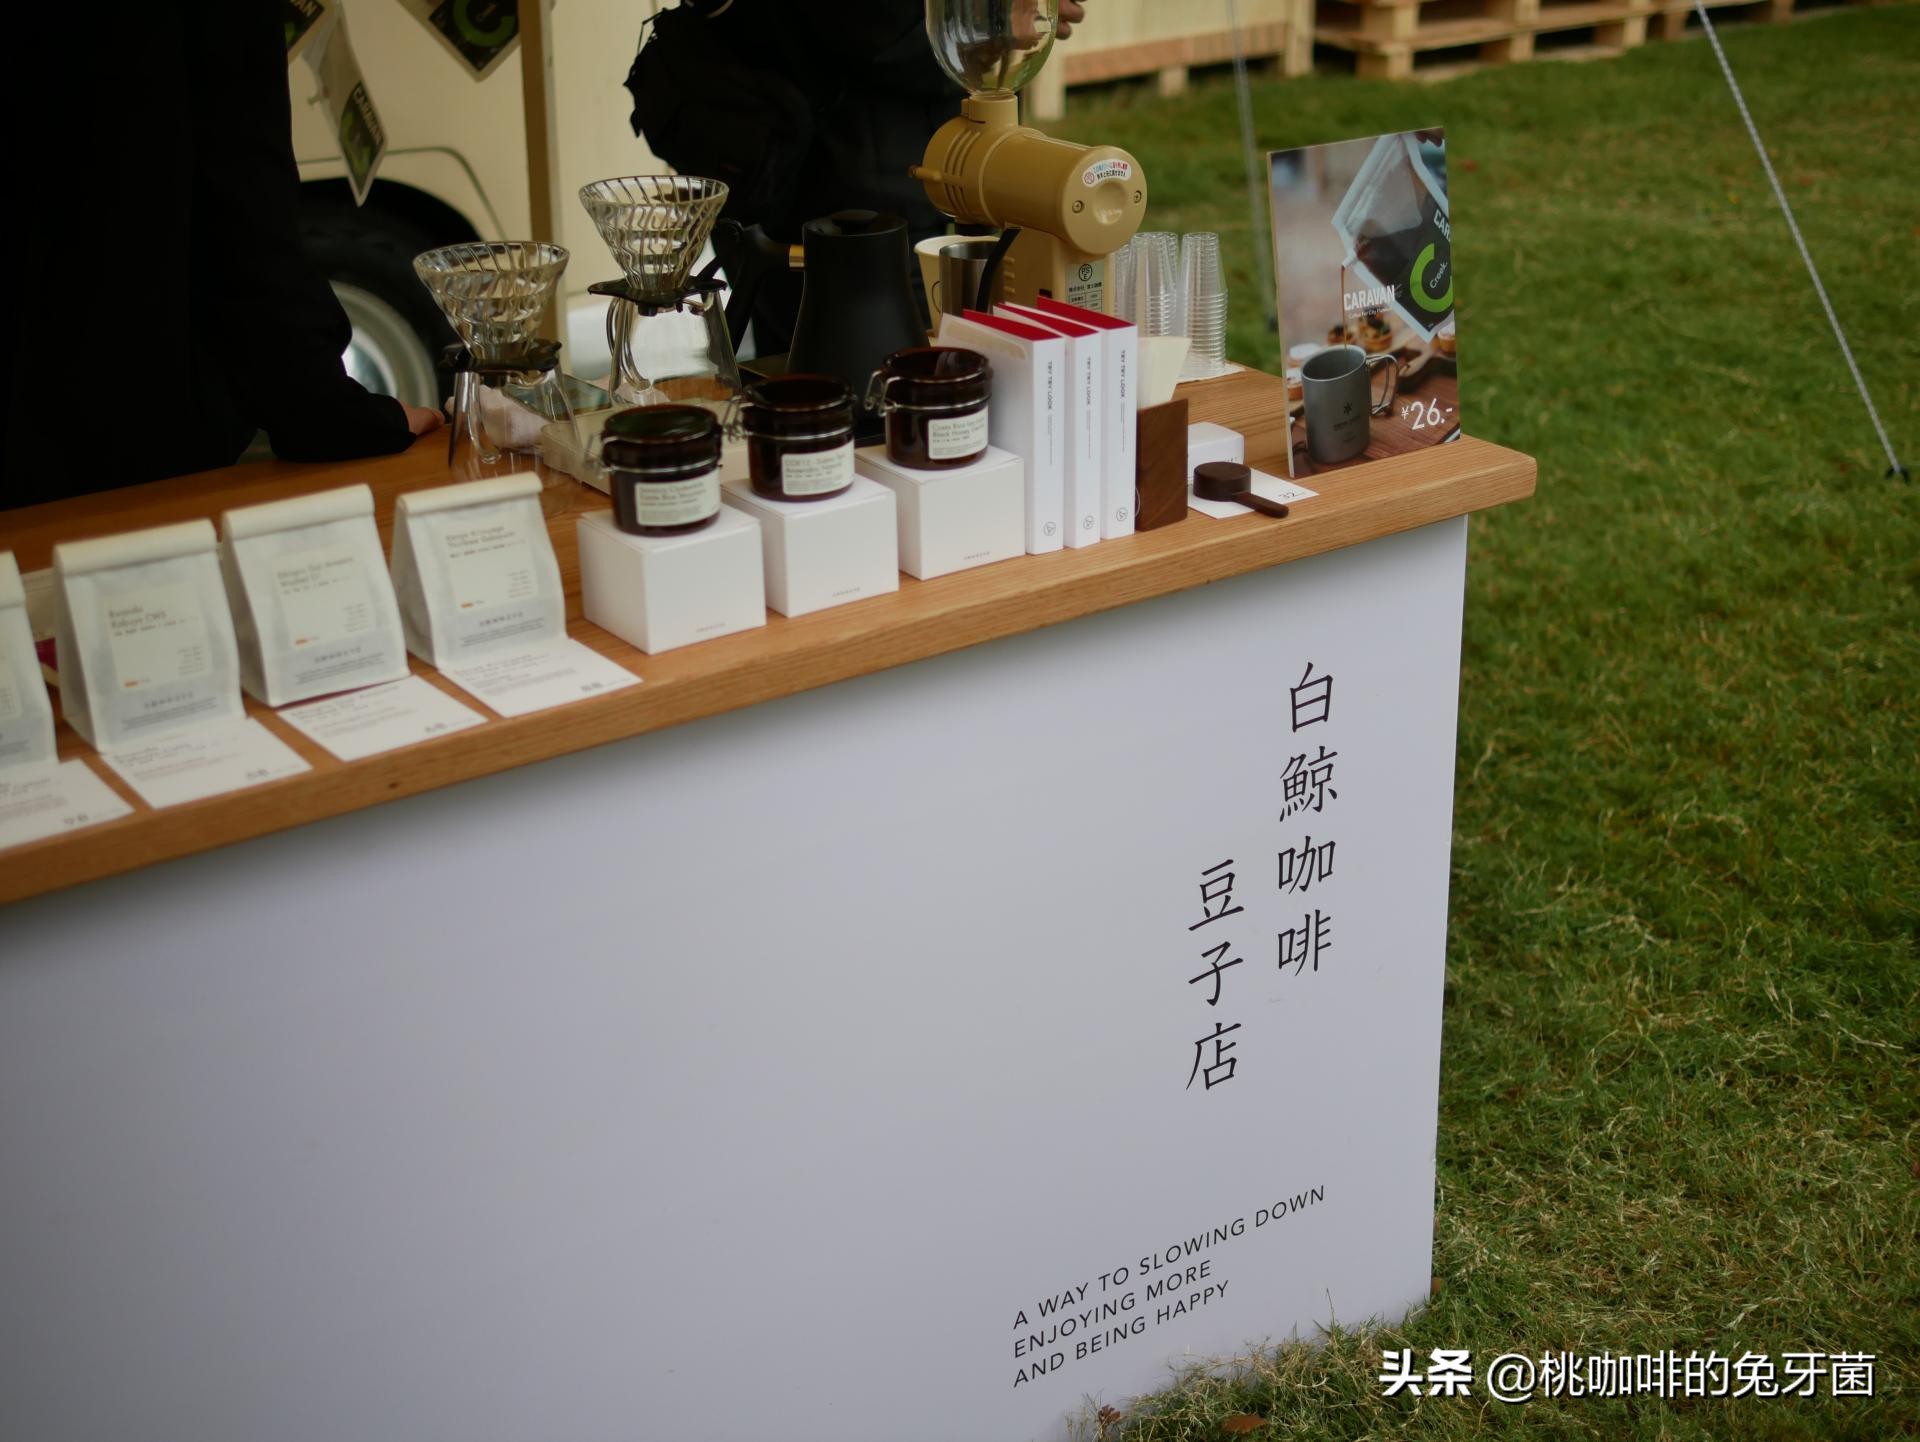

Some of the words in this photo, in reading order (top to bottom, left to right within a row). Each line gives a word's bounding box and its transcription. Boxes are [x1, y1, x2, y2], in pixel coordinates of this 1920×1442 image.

[1344, 285, 1395, 311] CARAVAN
[1277, 661, 1339, 977] 白鯨咖啡
[1185, 858, 1245, 1091] 豆子店
[1012, 1309, 1029, 1331] A
[1037, 1281, 1089, 1318] WAY
[1097, 1266, 1130, 1292] TO
[1139, 1217, 1245, 1276] SLOWING
[1255, 1184, 1325, 1228] DOWN
[1014, 1291, 1135, 1359] ENJOYING
[1146, 1259, 1212, 1302] MORE
[1013, 1352, 1065, 1389] AND
[1075, 1315, 1146, 1361] BEING
[1156, 1279, 1230, 1326] HAPPY
